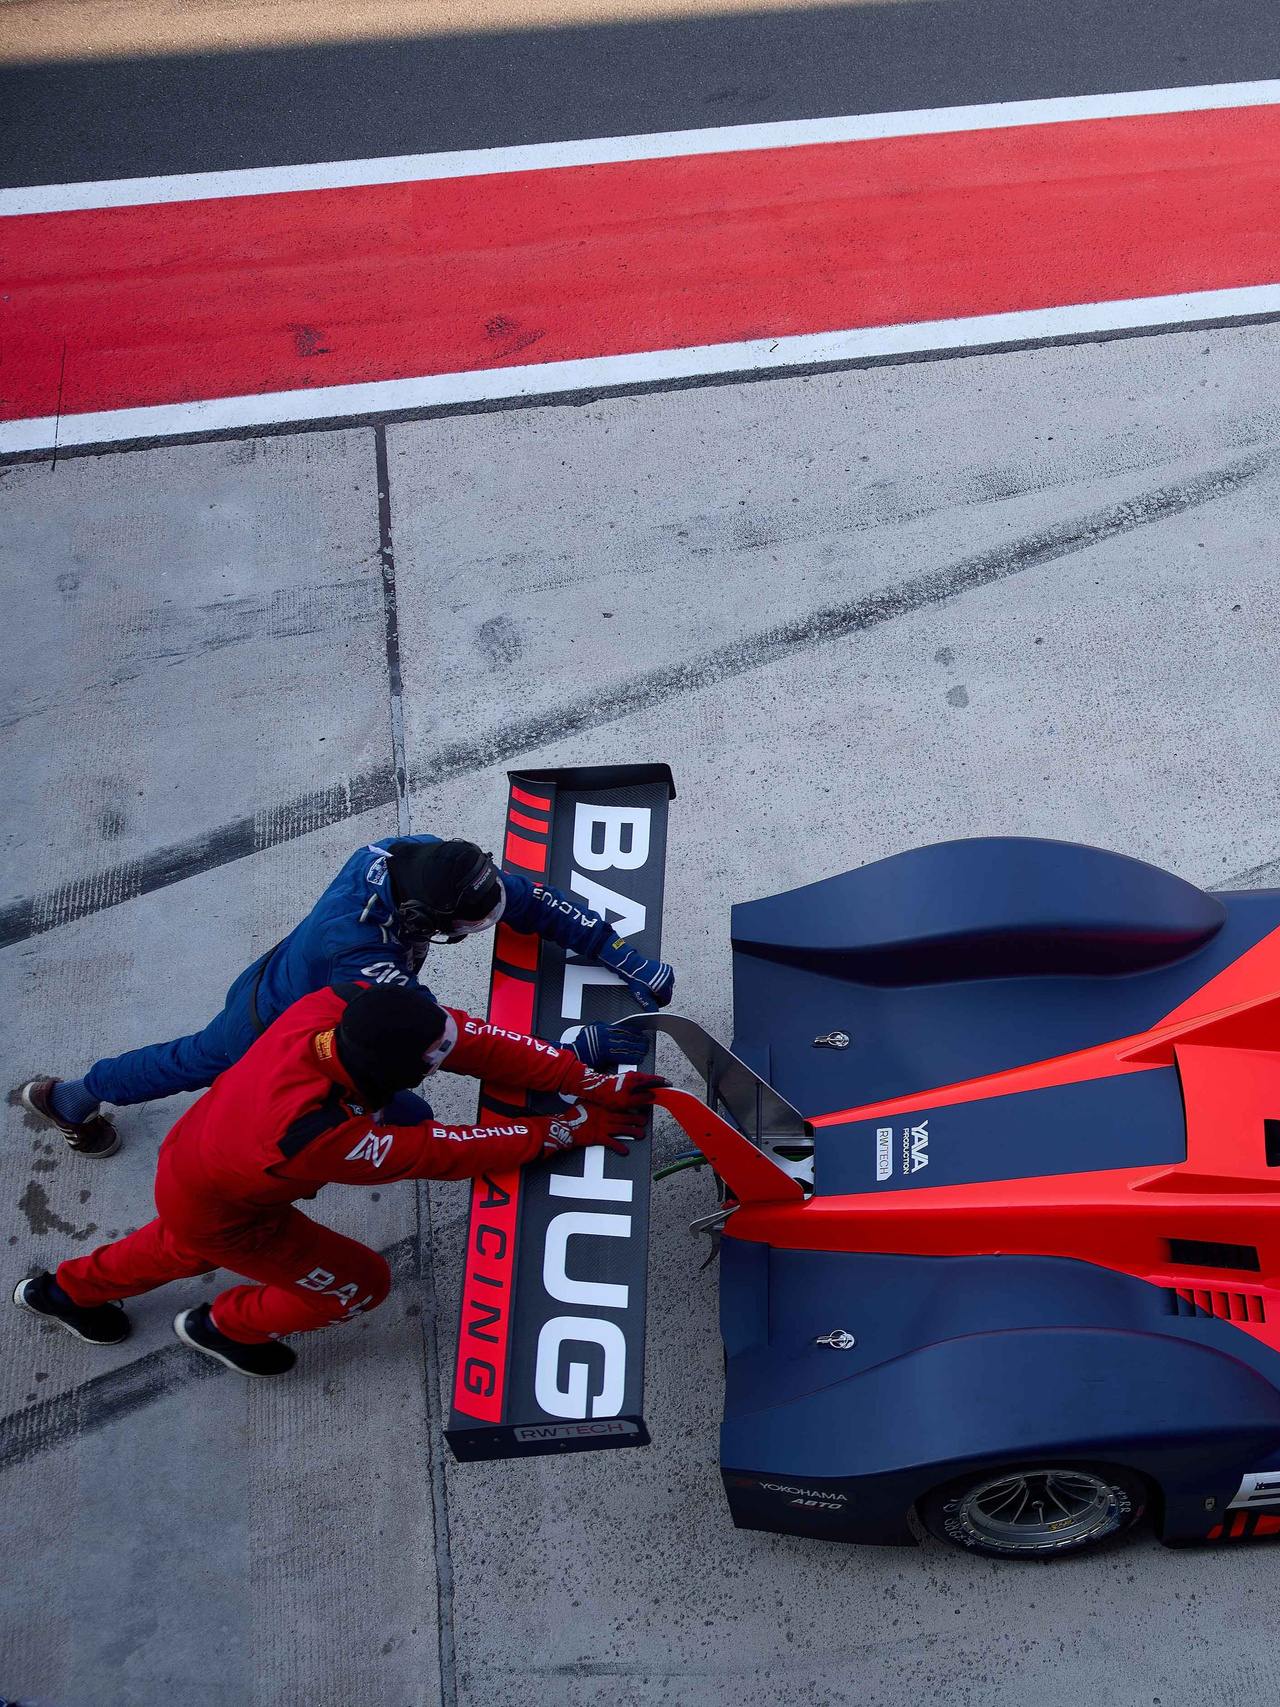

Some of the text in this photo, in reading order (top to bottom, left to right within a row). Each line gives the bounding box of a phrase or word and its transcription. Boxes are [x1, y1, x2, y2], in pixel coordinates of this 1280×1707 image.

[432, 1124, 529, 1142] BALCHUG
[534, 802, 651, 1419] BALHUG
[879, 1130, 889, 1175] RWTECH
[902, 1127, 910, 1175] PRODUCTION
[911, 1119, 929, 1173] YAVA
[463, 1173, 511, 1398] ACING
[520, 1422, 624, 1440] RWTECH
[758, 1481, 848, 1501] YOKOHAMA
